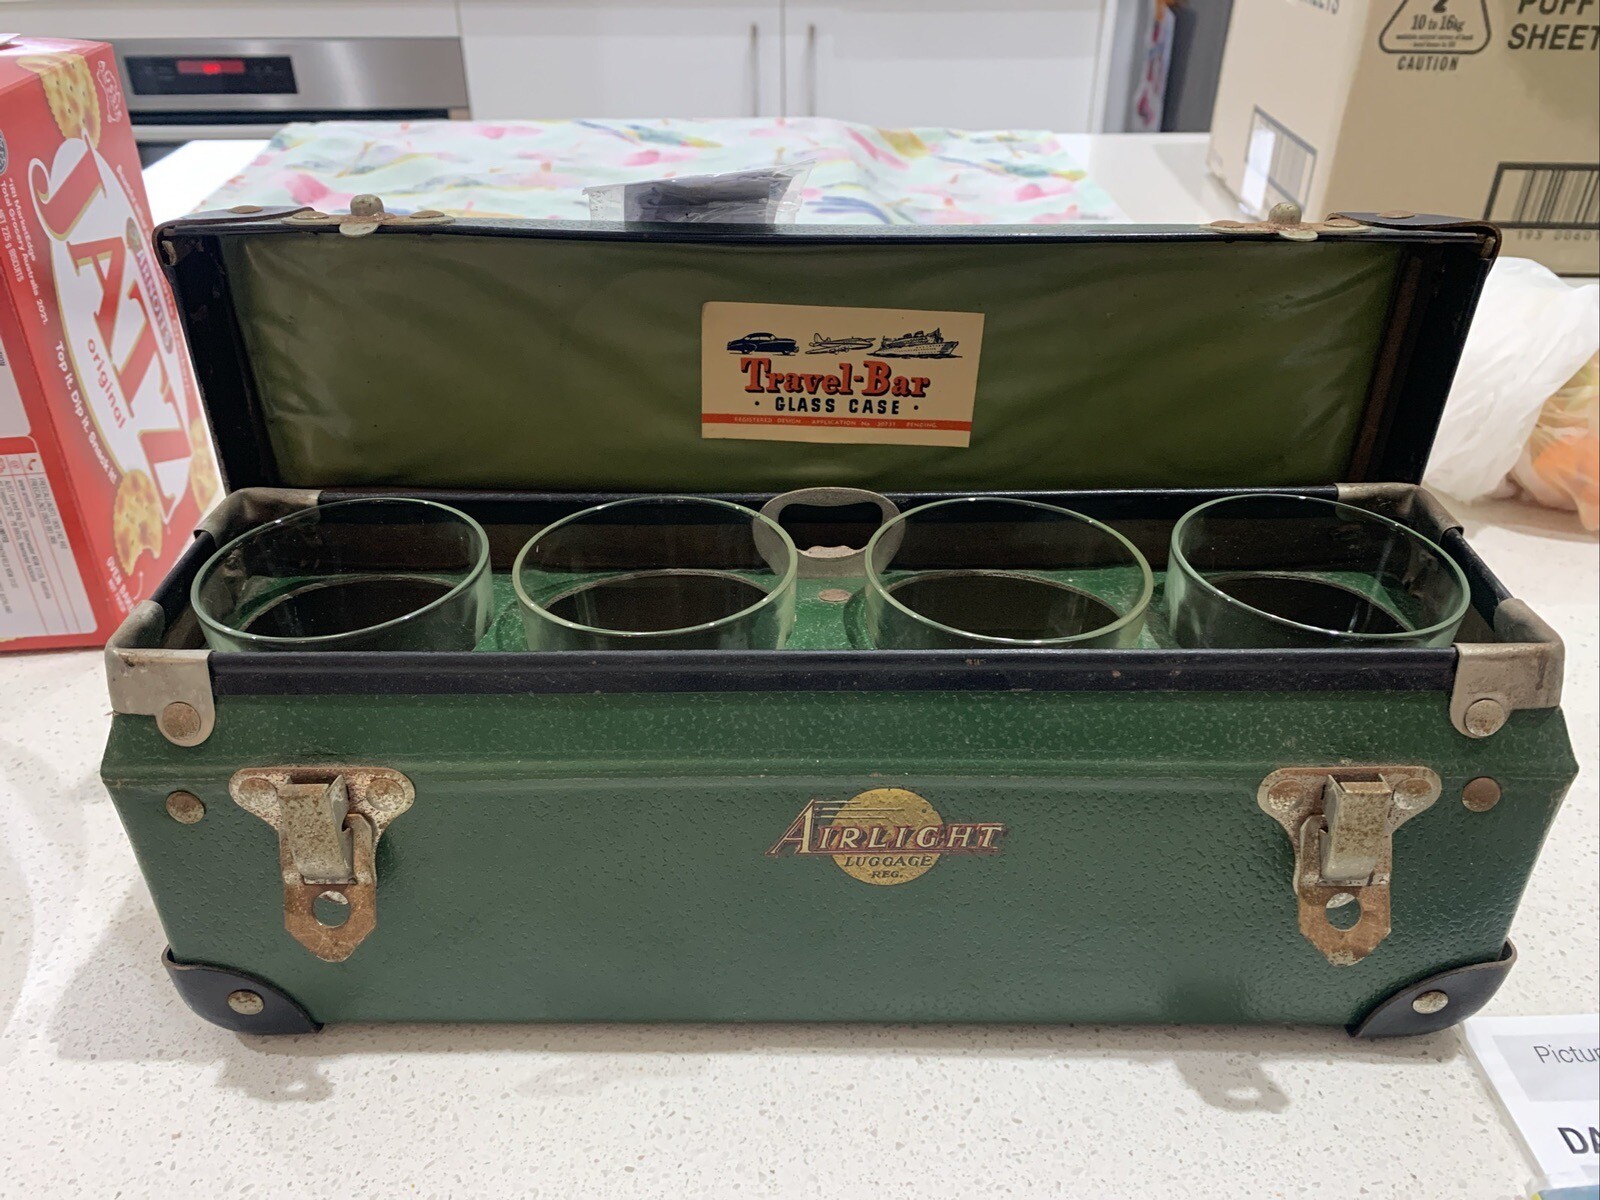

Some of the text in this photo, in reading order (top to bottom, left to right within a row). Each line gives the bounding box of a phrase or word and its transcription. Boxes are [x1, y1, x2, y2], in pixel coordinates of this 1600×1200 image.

[1397, 56, 1459, 71] CAUTION
[8, 248, 24, 283] BISCUITS
[9, 208, 25, 251] Grocery
[22, 253, 39, 296] Australia
[29, 128, 193, 525] JATZ
[88, 338, 126, 429] original
[740, 357, 931, 398] Travel-Bar
[55, 340, 68, 372] Top
[65, 372, 74, 390] it.
[71, 390, 84, 417] Dip
[88, 431, 109, 473] Snack
[775, 397, 900, 415] GLASS CASE
[765, 798, 1007, 855] AIRLIGHT
[843, 855, 933, 868] LUGGAGE
[870, 869, 903, 879] REG.
